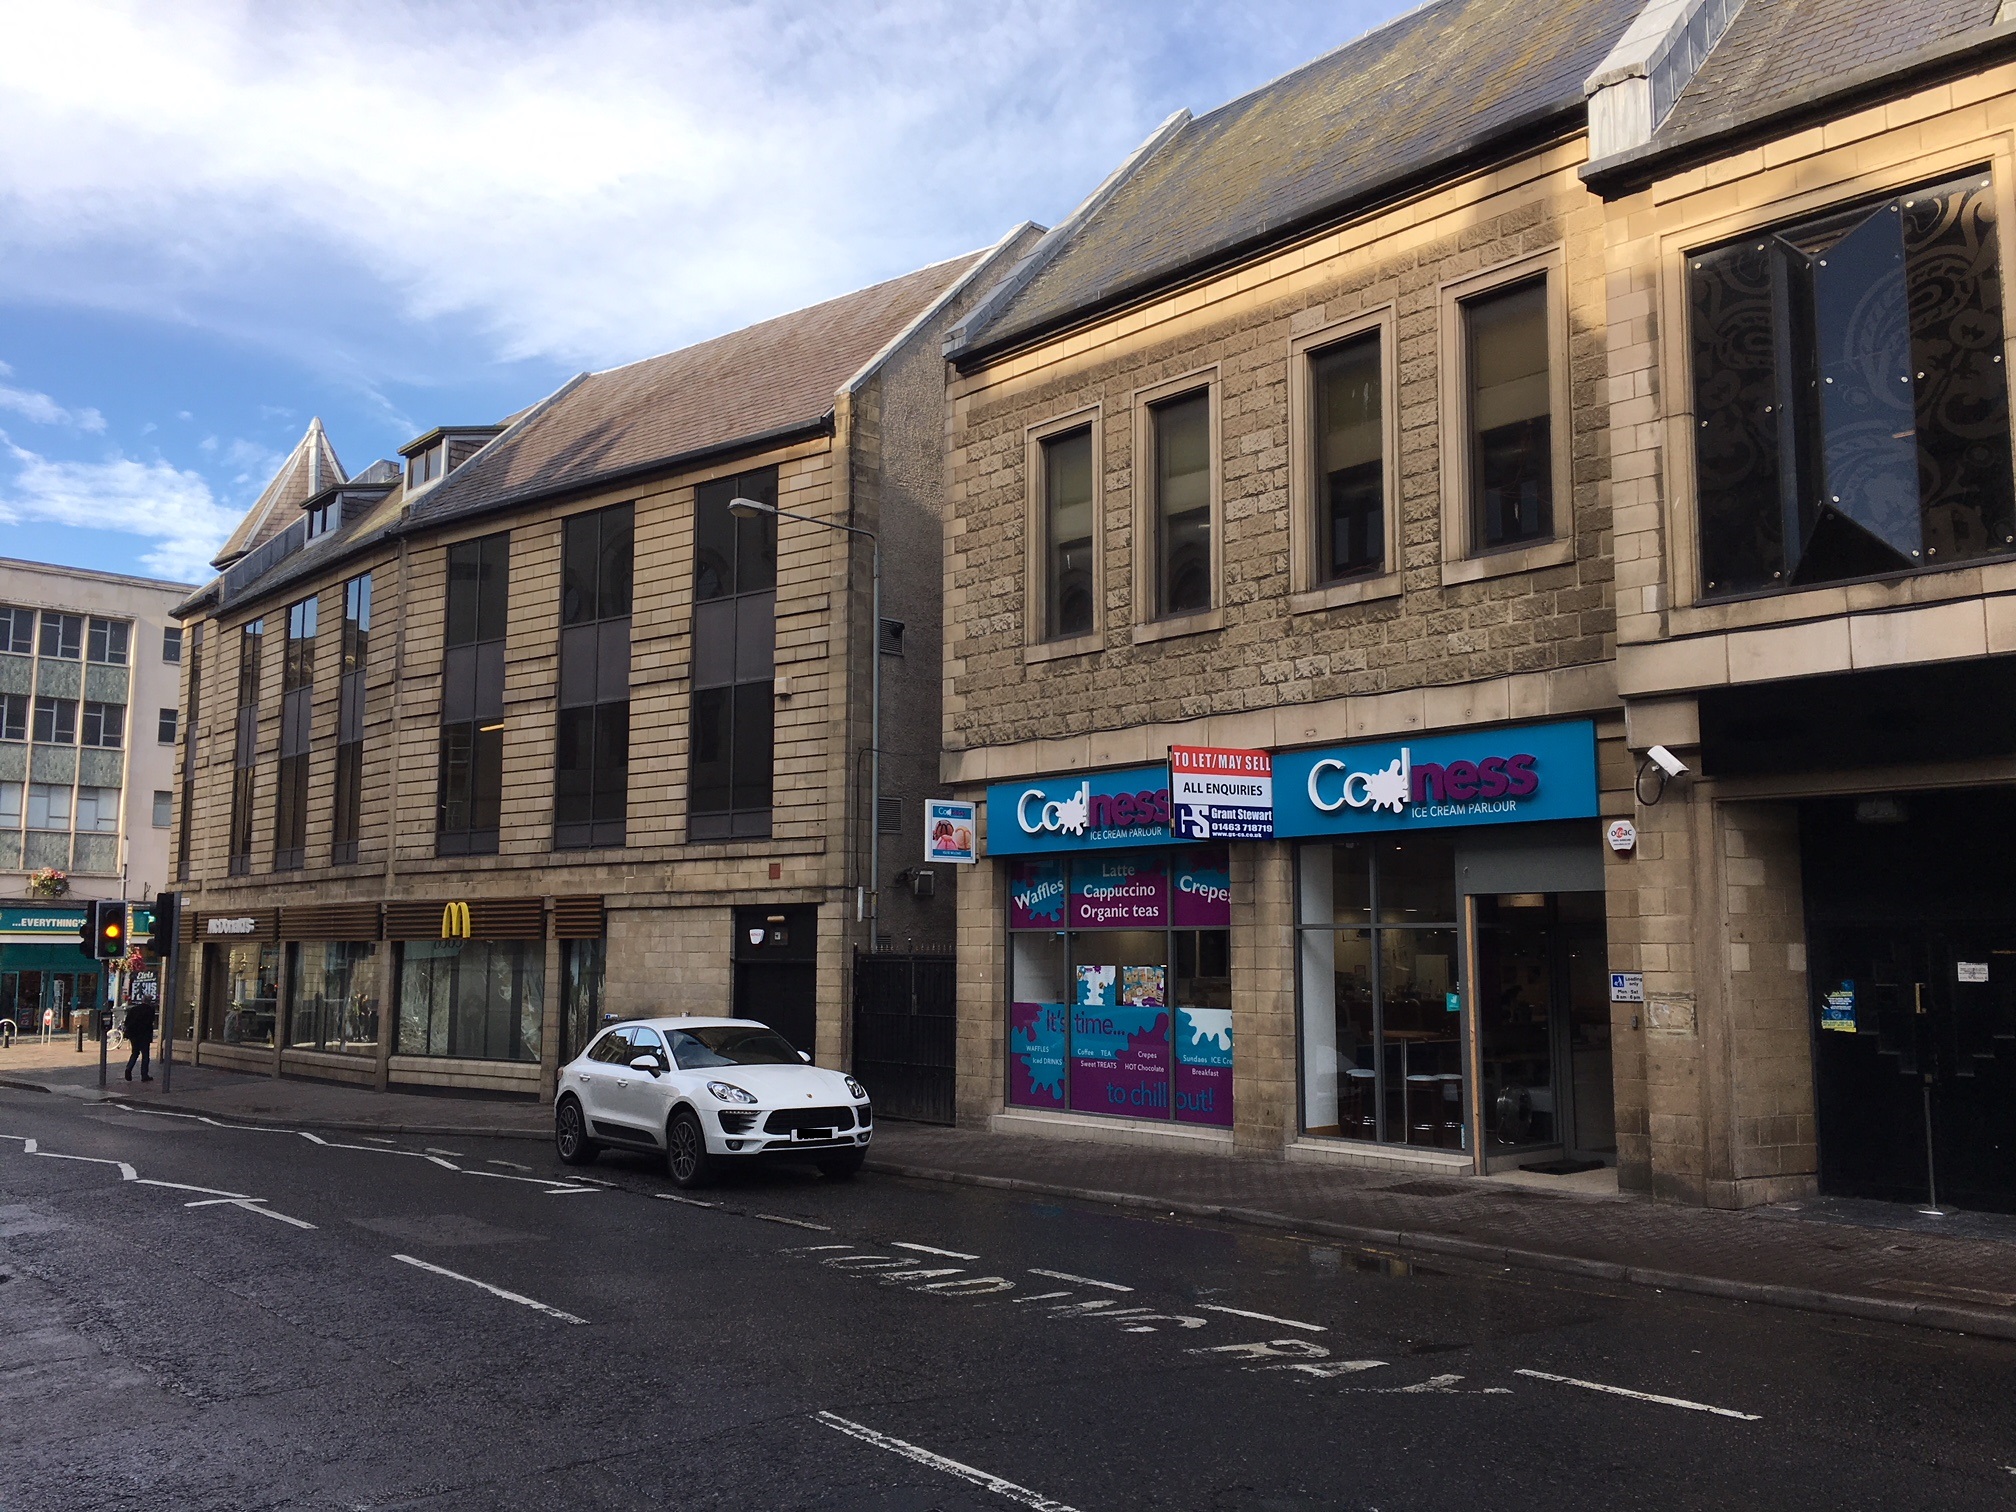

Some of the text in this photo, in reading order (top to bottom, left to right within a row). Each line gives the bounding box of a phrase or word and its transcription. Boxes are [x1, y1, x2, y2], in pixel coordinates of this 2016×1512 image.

[1174, 752, 1271, 771] TO LET/MAY SELL
[1183, 782, 1263, 796] ALL ENQUIRIES
[1211, 808, 1272, 821] Grant Stewart
[1411, 800, 1517, 818] ICE CREAM PARLOUR
[1211, 822, 1273, 832] 01463 718719
[1090, 827, 1162, 841] ICE CREAM PARLOUR
[1102, 864, 1135, 877] Latte
[1014, 879, 1064, 910] Waffles
[1083, 883, 1156, 901] Cappuccino
[1080, 904, 1159, 922] Organic teas
[1046, 1009, 1125, 1036] It's time...
[1026, 1045, 1049, 1053] WAFFLES
[1077, 1048, 1094, 1056] Coffee
[1138, 1051, 1157, 1060] Crepes
[1032, 1057, 1063, 1066] Iced DRINKS
[1080, 1060, 1117, 1069] Sweet TREATS
[1183, 1054, 1208, 1063] Sundaes
[1211, 1056, 1221, 1064] ICE
[1137, 1064, 1164, 1073] Chocolate
[1191, 1068, 1219, 1077] Breakfast
[1107, 1080, 1215, 1112] to chill out!
